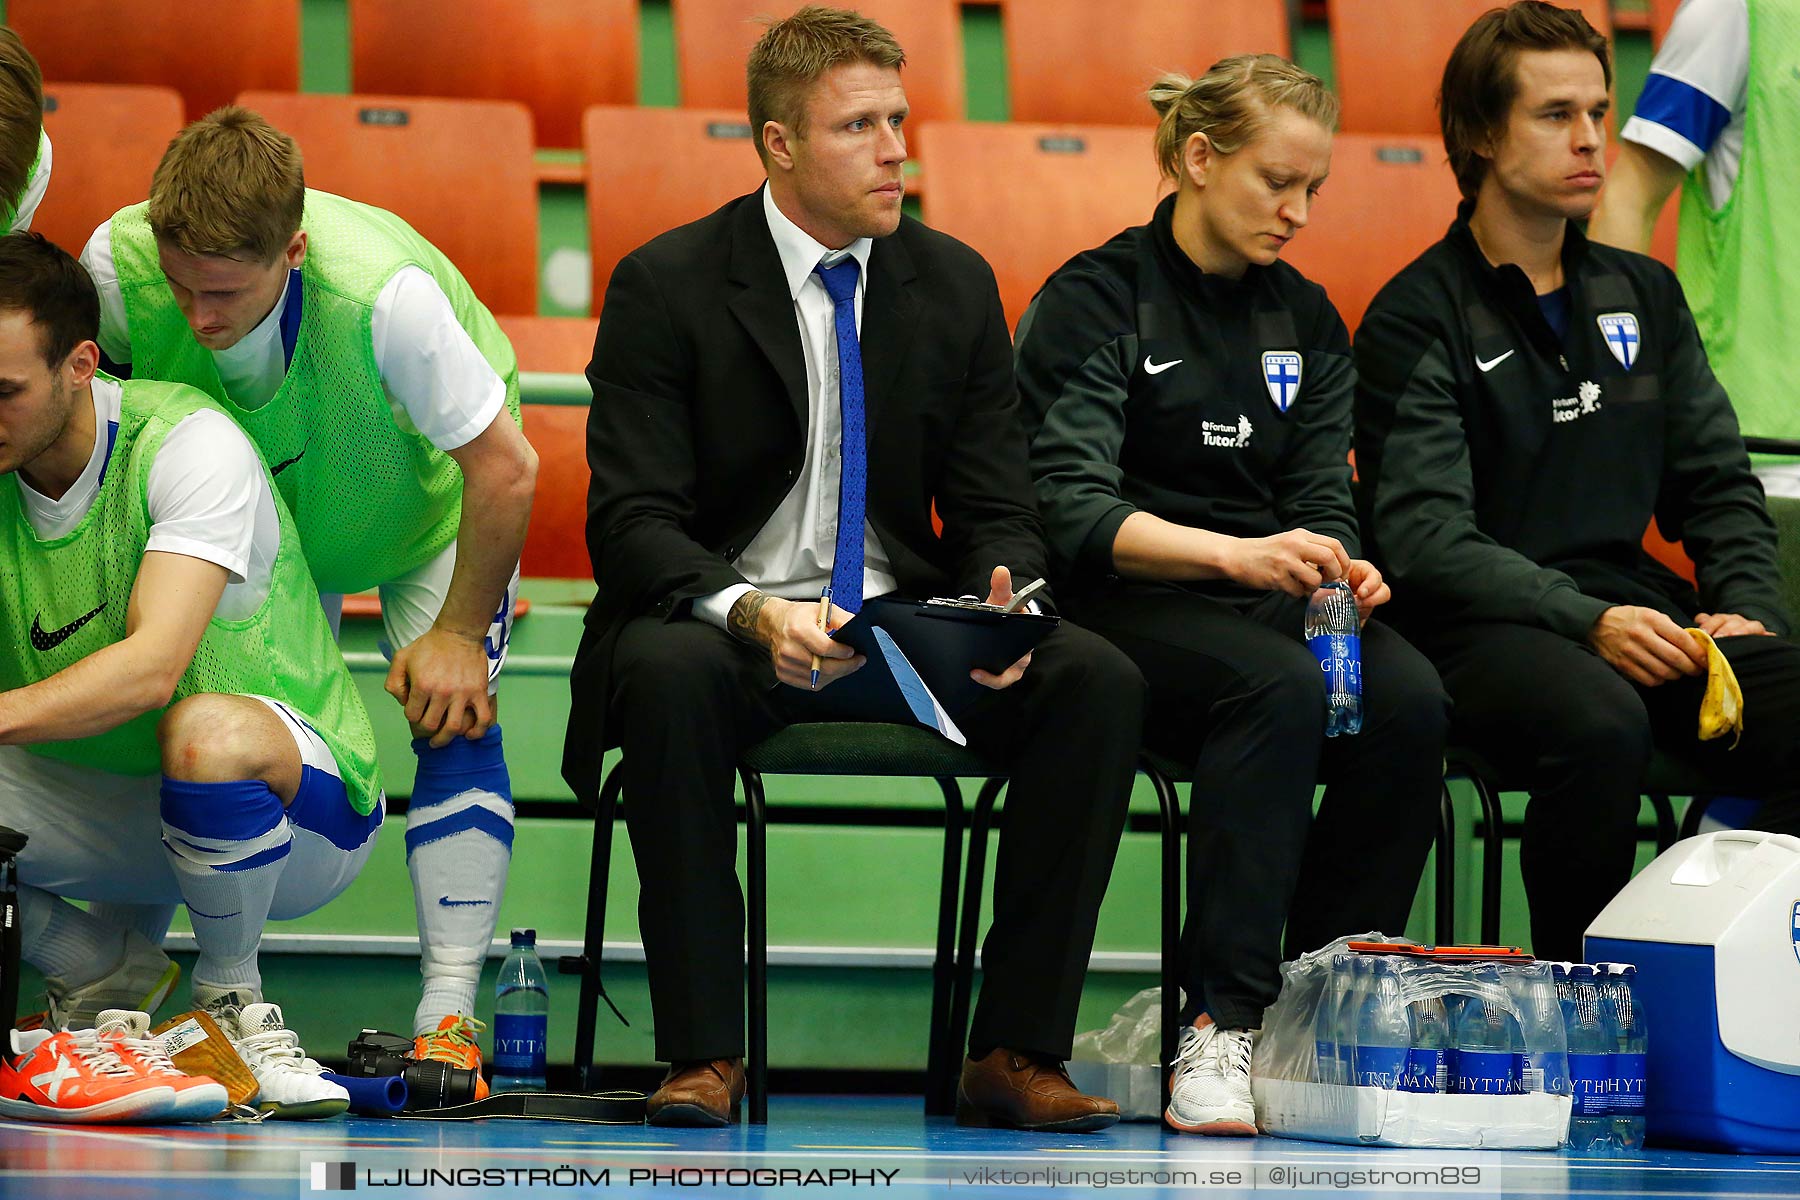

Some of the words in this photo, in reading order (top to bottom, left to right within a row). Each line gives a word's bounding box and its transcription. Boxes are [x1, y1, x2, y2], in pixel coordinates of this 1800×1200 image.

[1202, 431, 1236, 447] Tutor
[1459, 1076, 1522, 1092] HYTTAN
[1608, 1078, 1646, 1092] HYT
